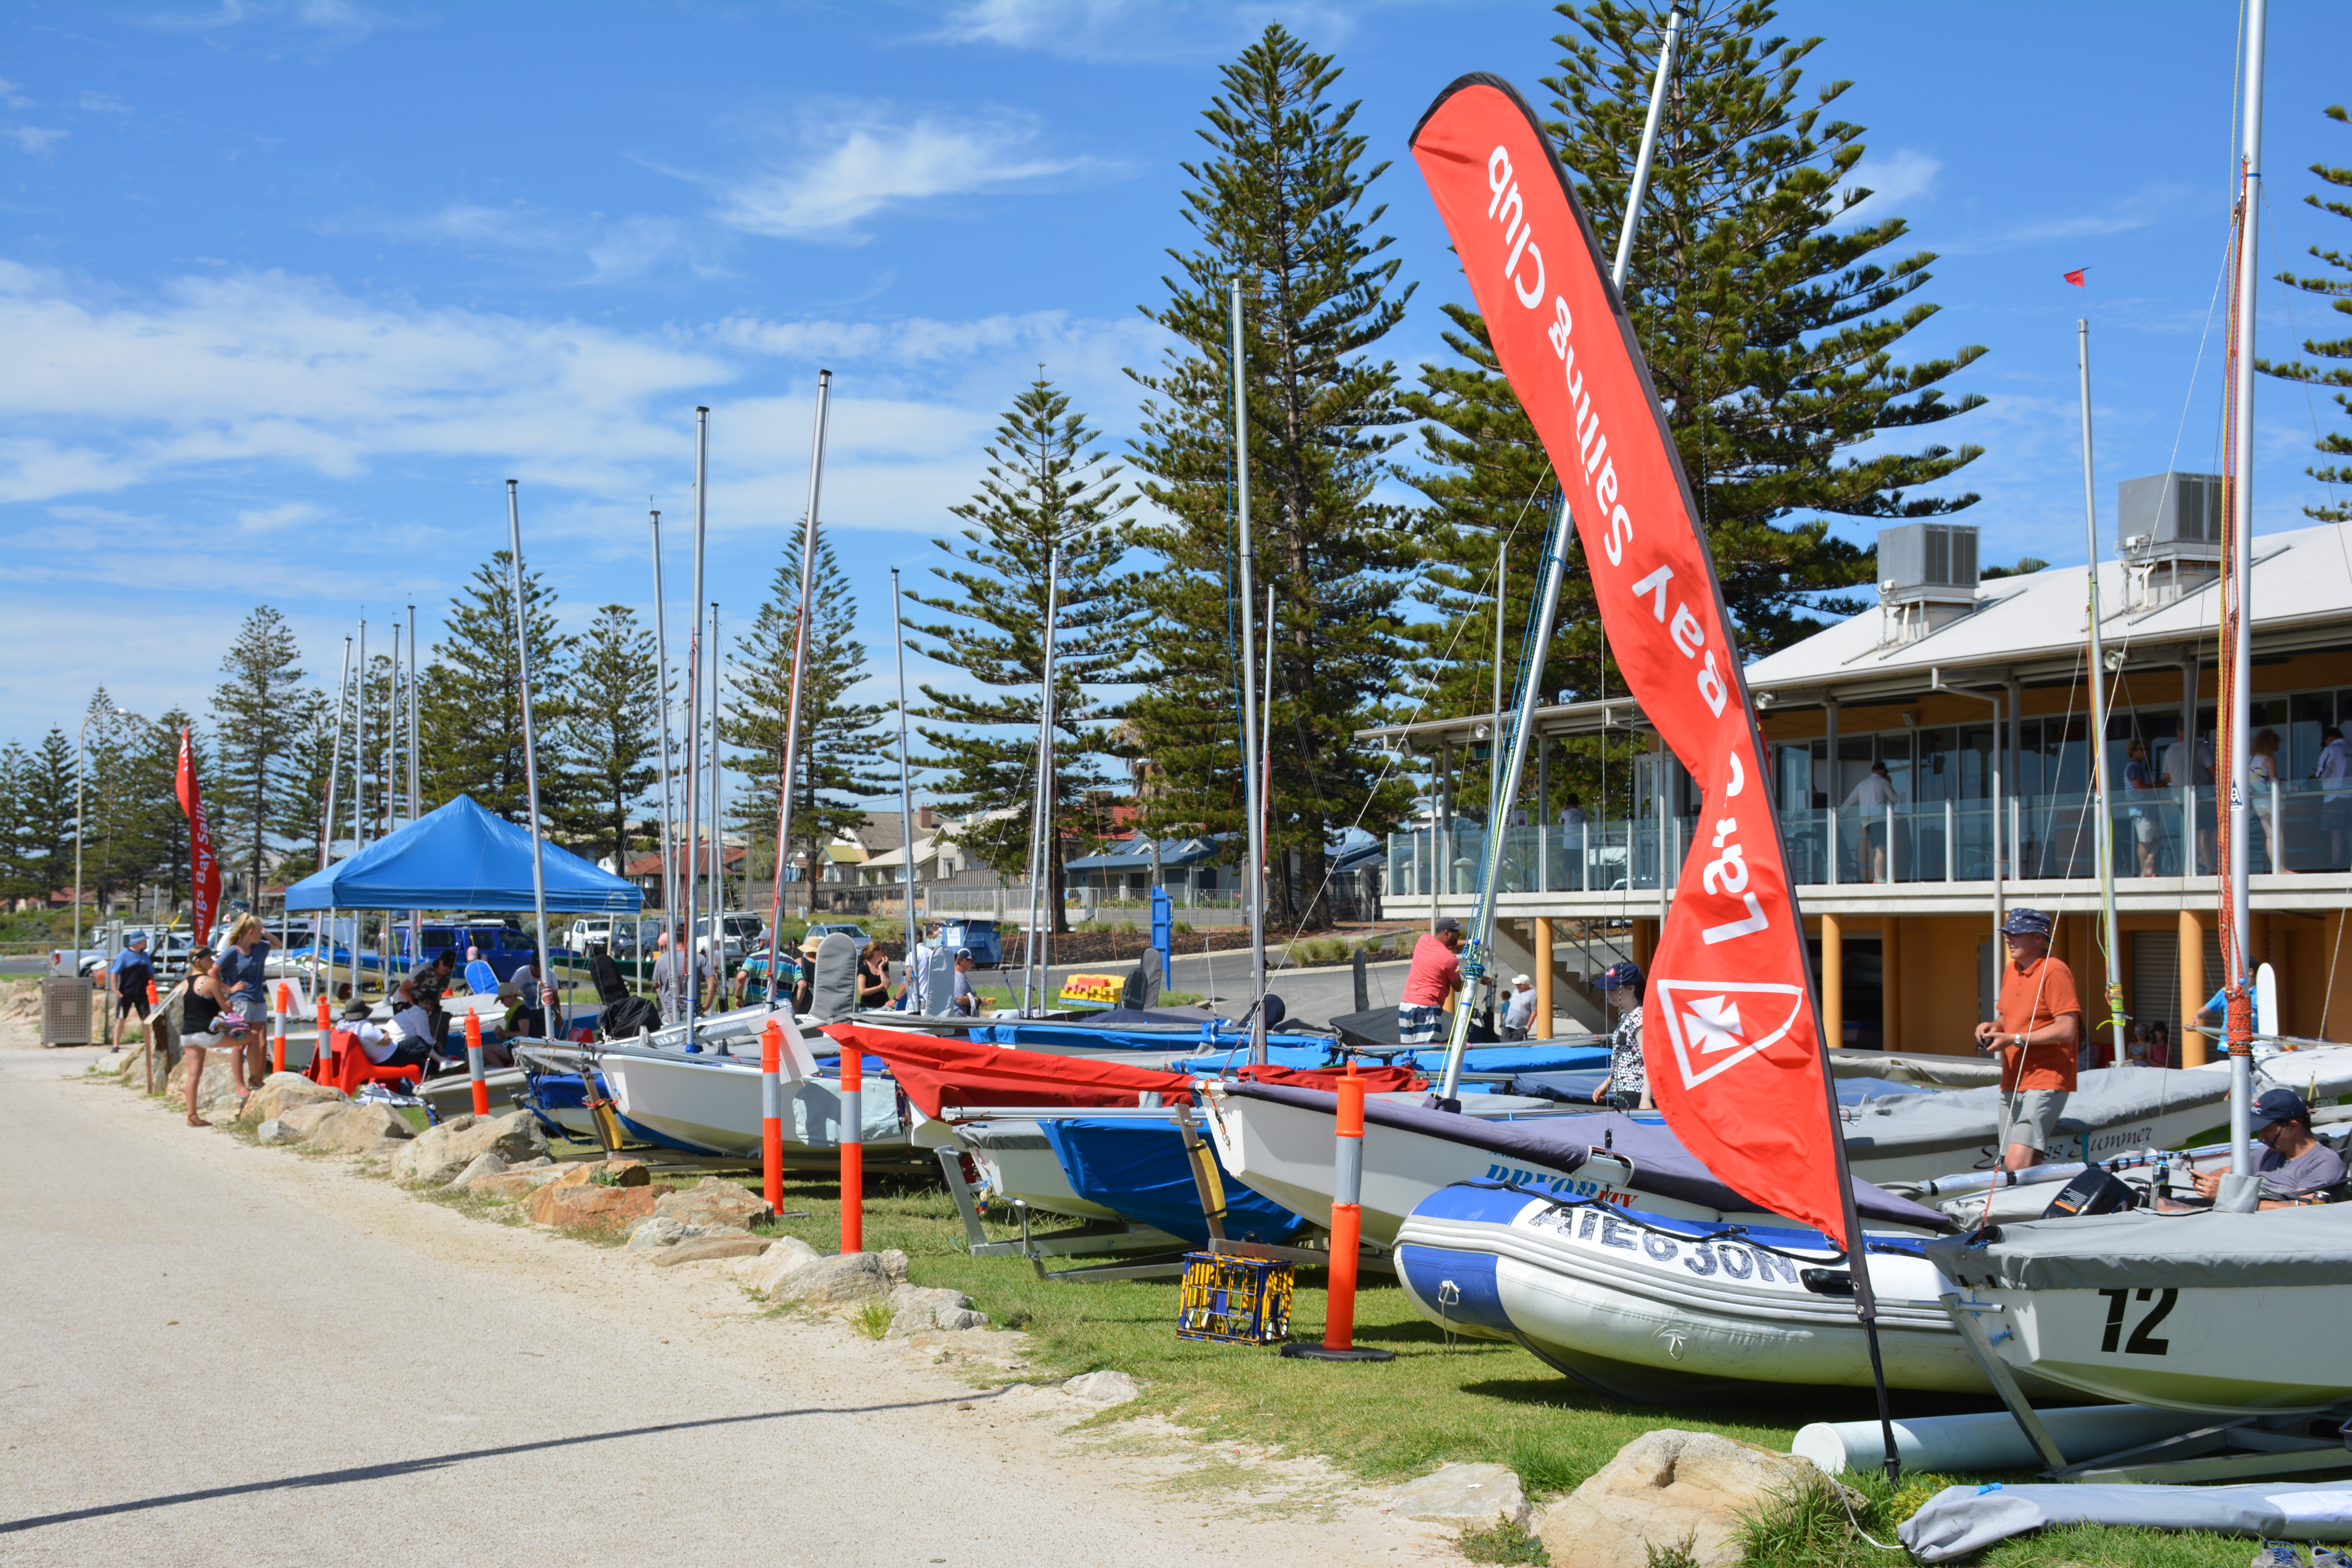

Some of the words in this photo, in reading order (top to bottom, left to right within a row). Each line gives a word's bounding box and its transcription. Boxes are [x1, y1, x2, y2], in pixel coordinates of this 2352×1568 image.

[1488, 145, 1545, 310] Club
[1548, 295, 1633, 567] Sailing
[1631, 564, 1727, 719] Bay
[196, 848, 212, 884] Bay
[2098, 1288, 2178, 1355] 12
